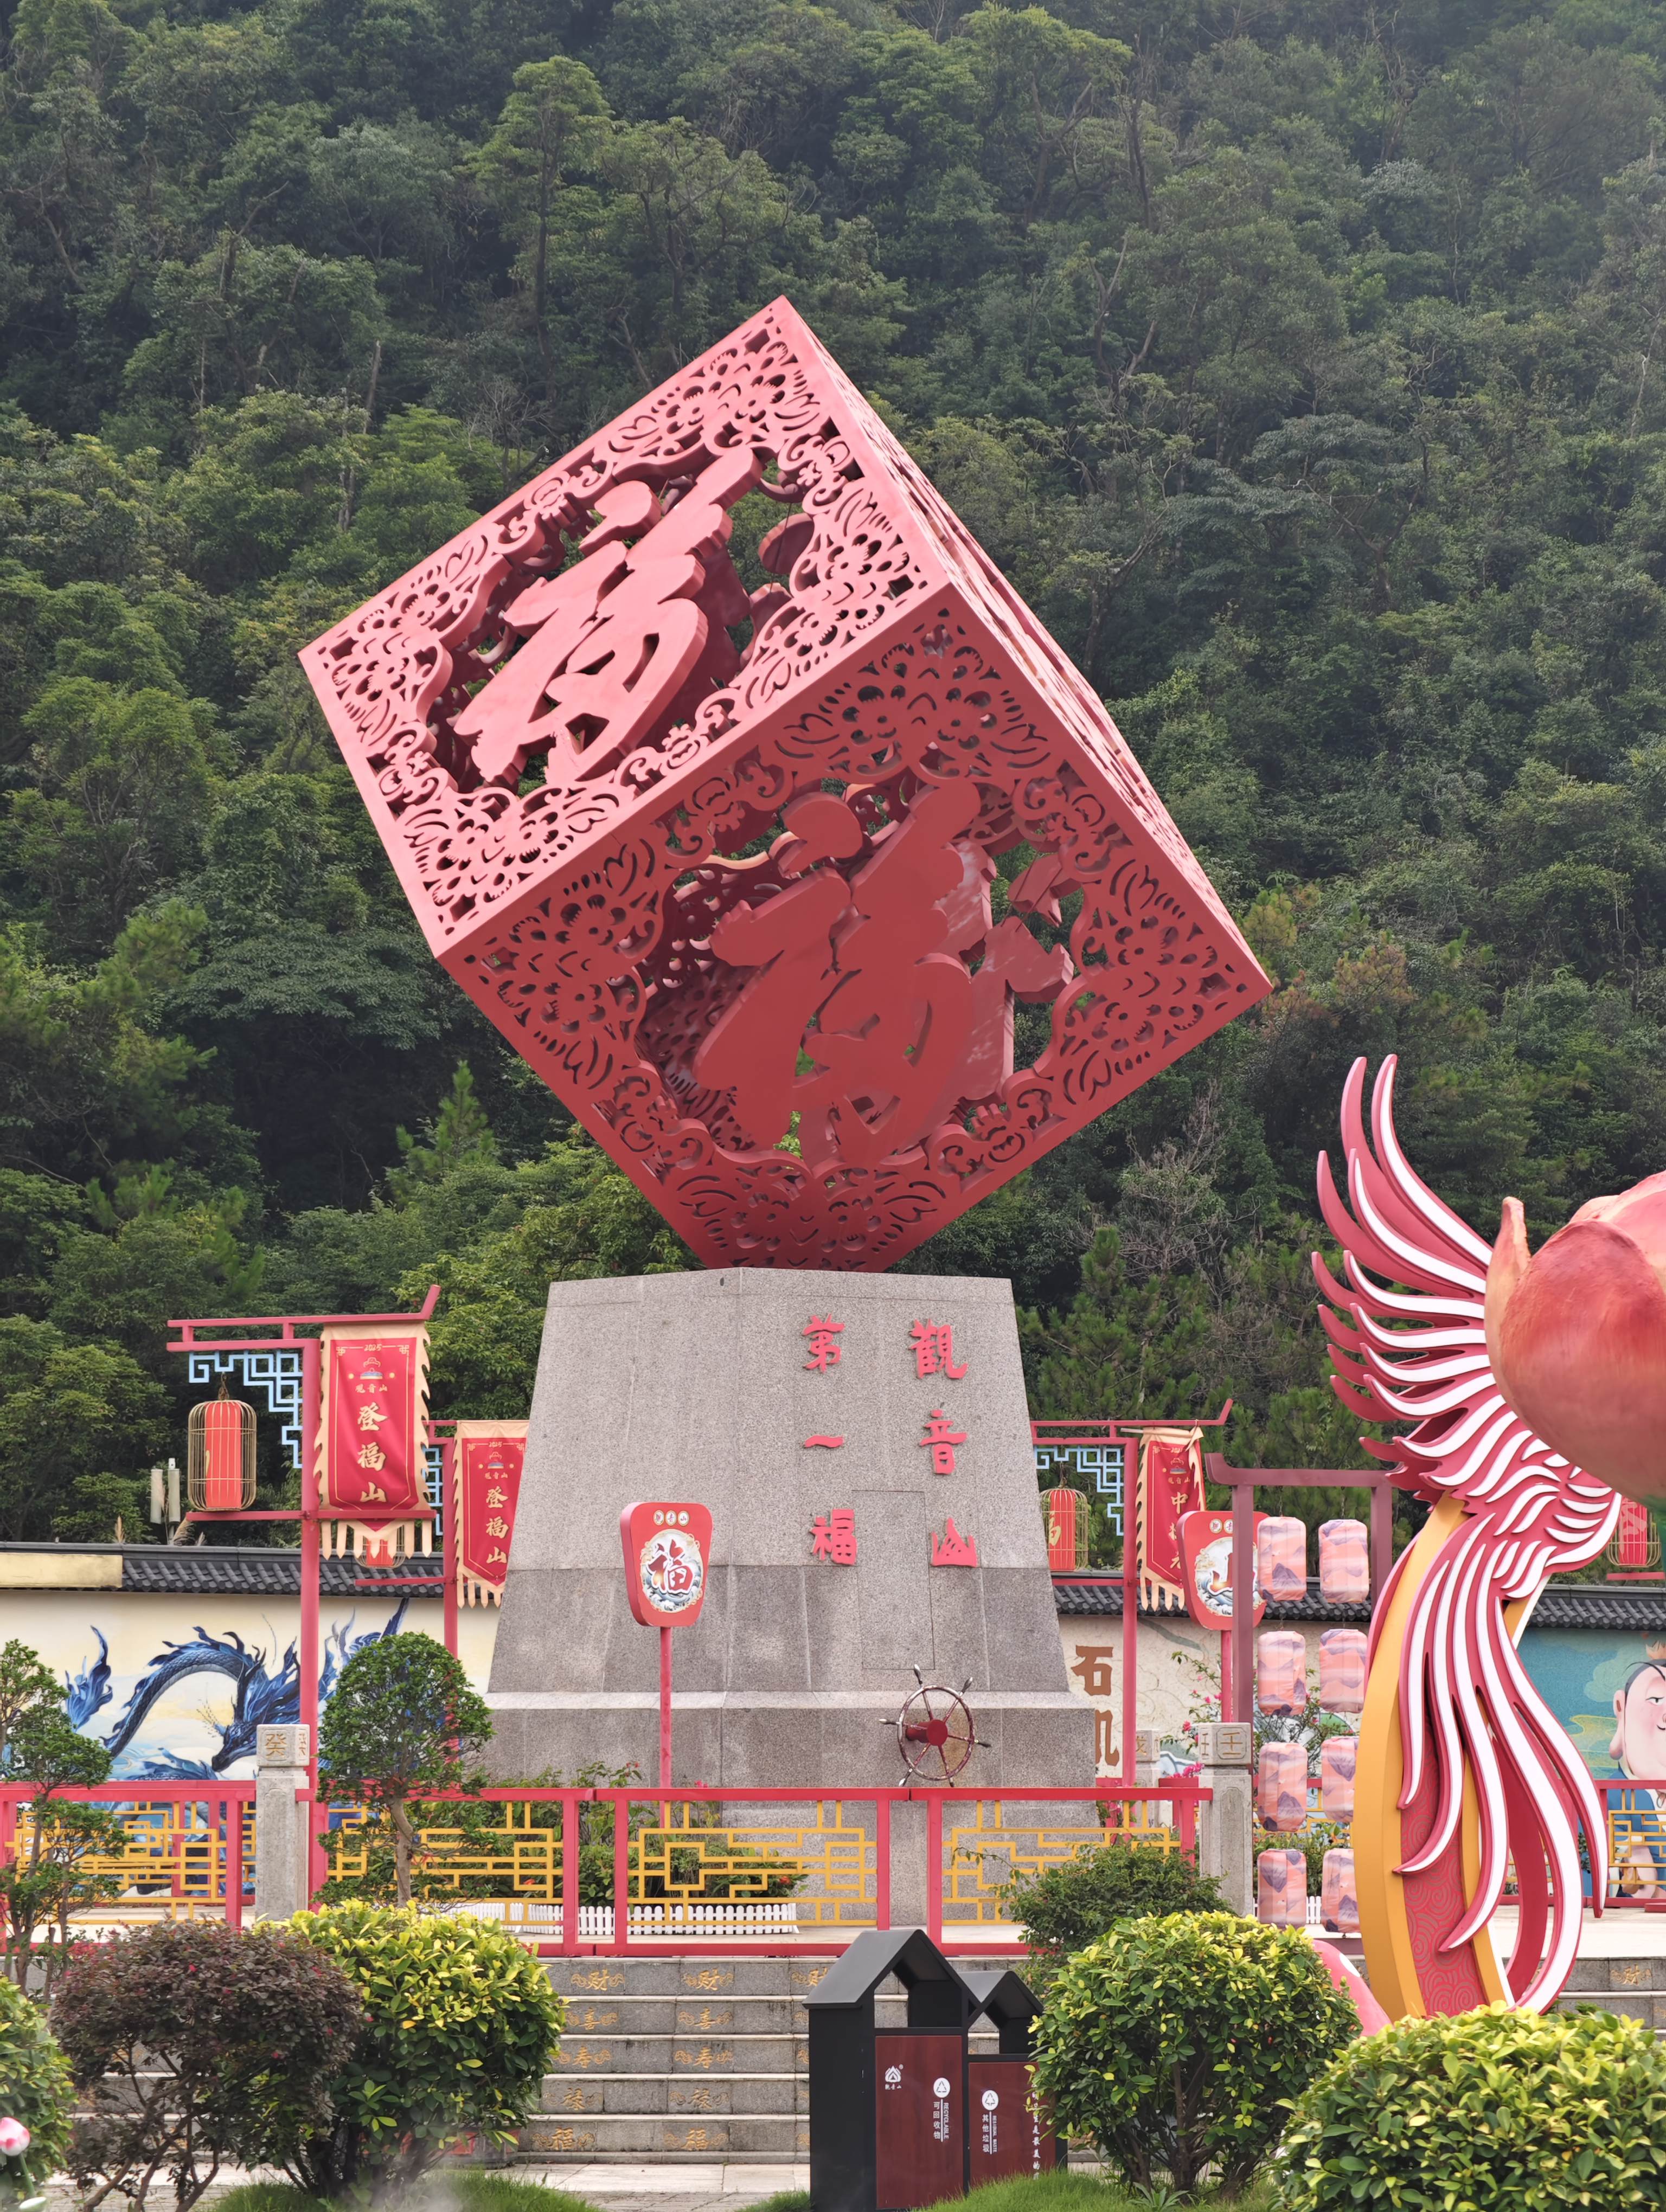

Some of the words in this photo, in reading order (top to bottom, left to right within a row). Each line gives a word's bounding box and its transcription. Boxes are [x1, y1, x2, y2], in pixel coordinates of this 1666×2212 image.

[454, 446, 762, 786] 福
[691, 784, 981, 1166] 福
[363, 1343, 382, 1352] 2025
[355, 1384, 388, 1394] 观音山
[357, 1401, 390, 1504] 登福山
[908, 1318, 977, 1568] 觀音山
[484, 1471, 509, 1480] 观音山
[485, 1485, 509, 1565] 登福山
[647, 1538, 694, 1592] 福
[265, 1731, 287, 1757] 癸
[579, 2007, 600, 2030] 喜
[694, 2007, 716, 2030] 喜
[548, 2126, 576, 2151] 福
[681, 2127, 711, 2151] 福
[933, 2101, 941, 2140] 可回收物
